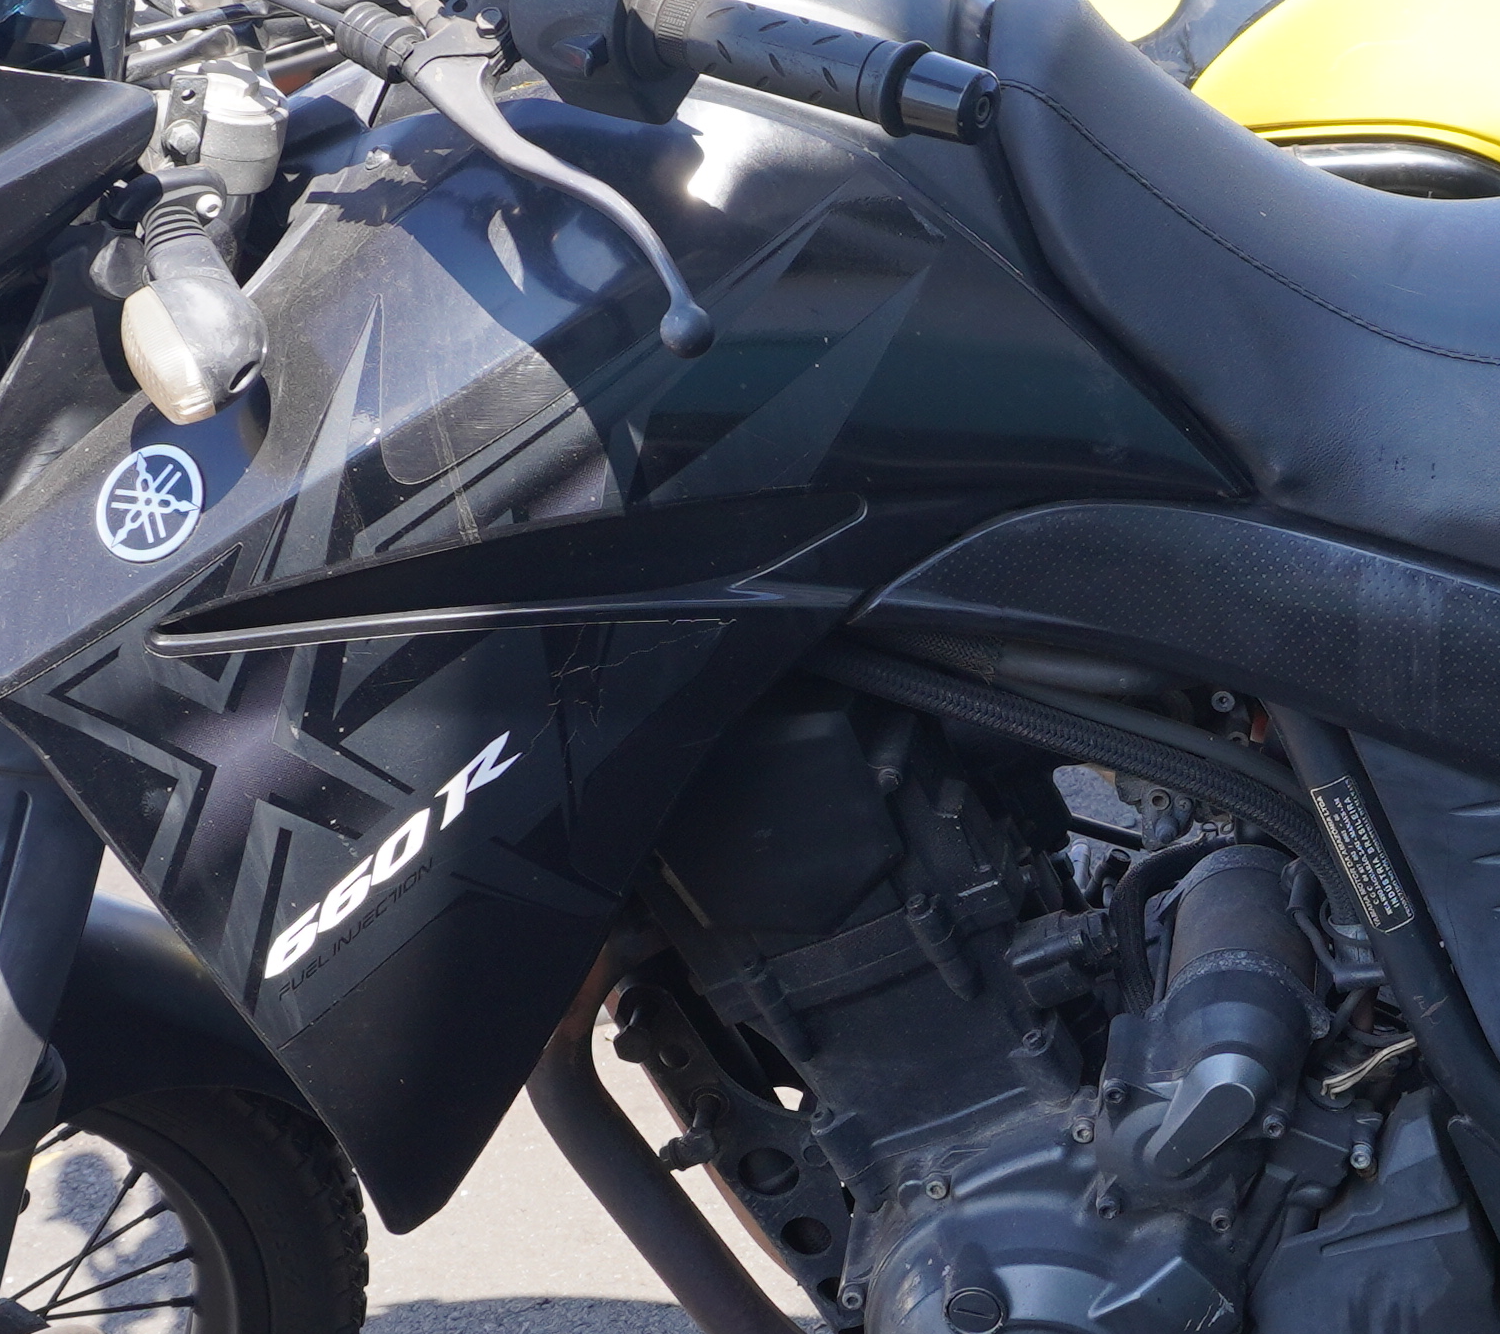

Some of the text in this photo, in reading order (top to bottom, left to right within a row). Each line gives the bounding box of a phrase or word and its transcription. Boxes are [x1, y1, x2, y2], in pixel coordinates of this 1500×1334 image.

[1342, 796, 1375, 854] BRASILEIRA
[278, 856, 435, 1003] FUEL INJECTION
